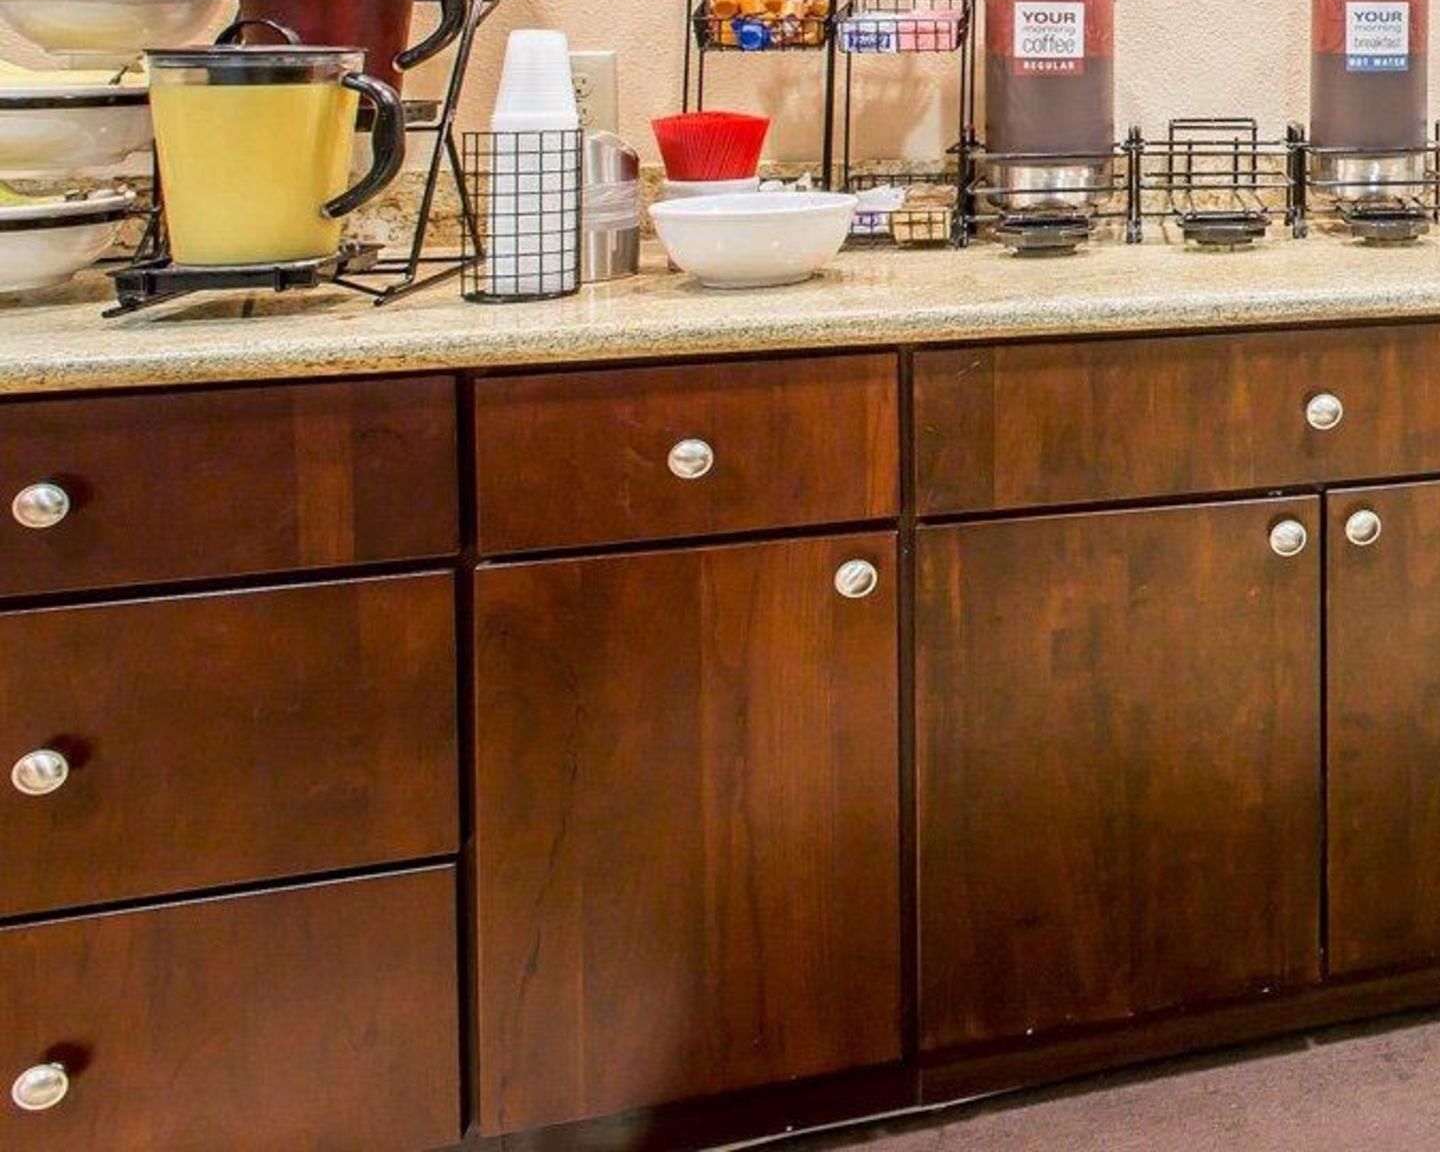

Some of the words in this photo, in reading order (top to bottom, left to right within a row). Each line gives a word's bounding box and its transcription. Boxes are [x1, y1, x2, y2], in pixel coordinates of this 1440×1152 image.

[1022, 11, 1076, 24] YOUR
[1354, 11, 1403, 23] YOUR
[1022, 33, 1076, 54] coffee
